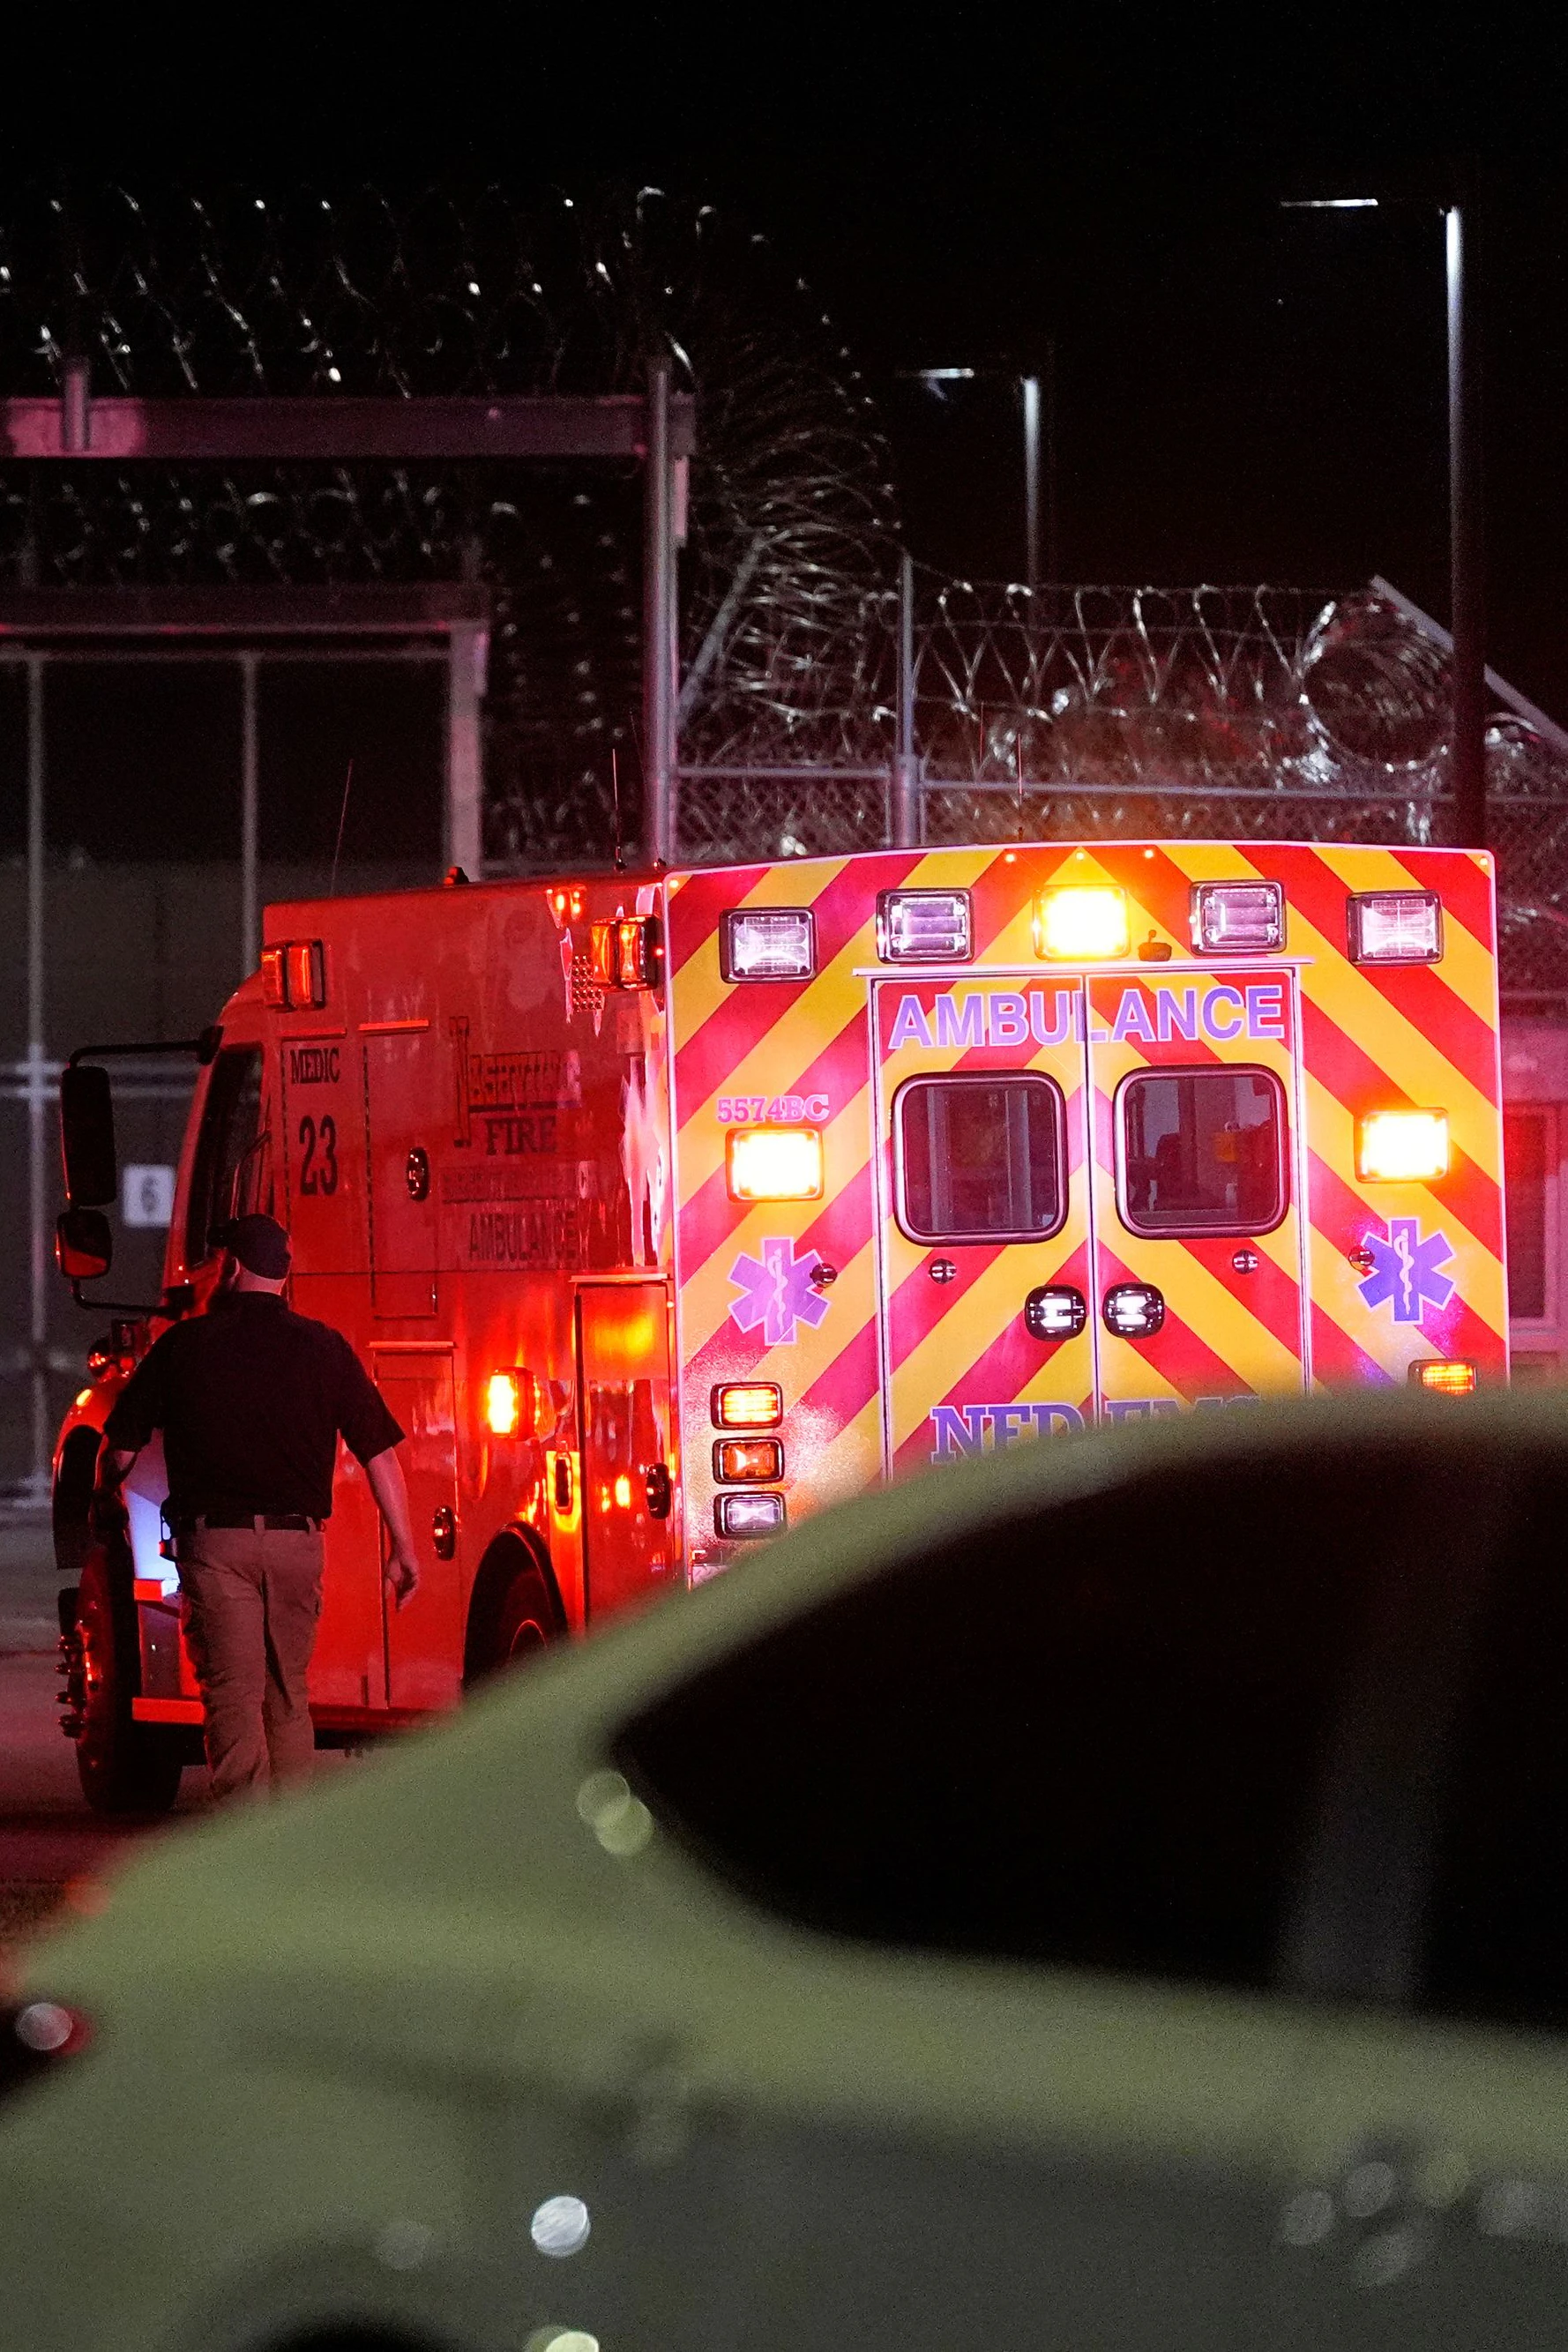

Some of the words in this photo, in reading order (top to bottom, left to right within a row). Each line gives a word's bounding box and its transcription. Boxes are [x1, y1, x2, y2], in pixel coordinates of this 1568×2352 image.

[887, 985, 1286, 1049] AMBULANCE
[290, 1047, 340, 1085] MEDIC
[717, 1094, 831, 1124] 5574BC
[298, 1114, 339, 1196] 23
[484, 1115, 557, 1155] FIRE
